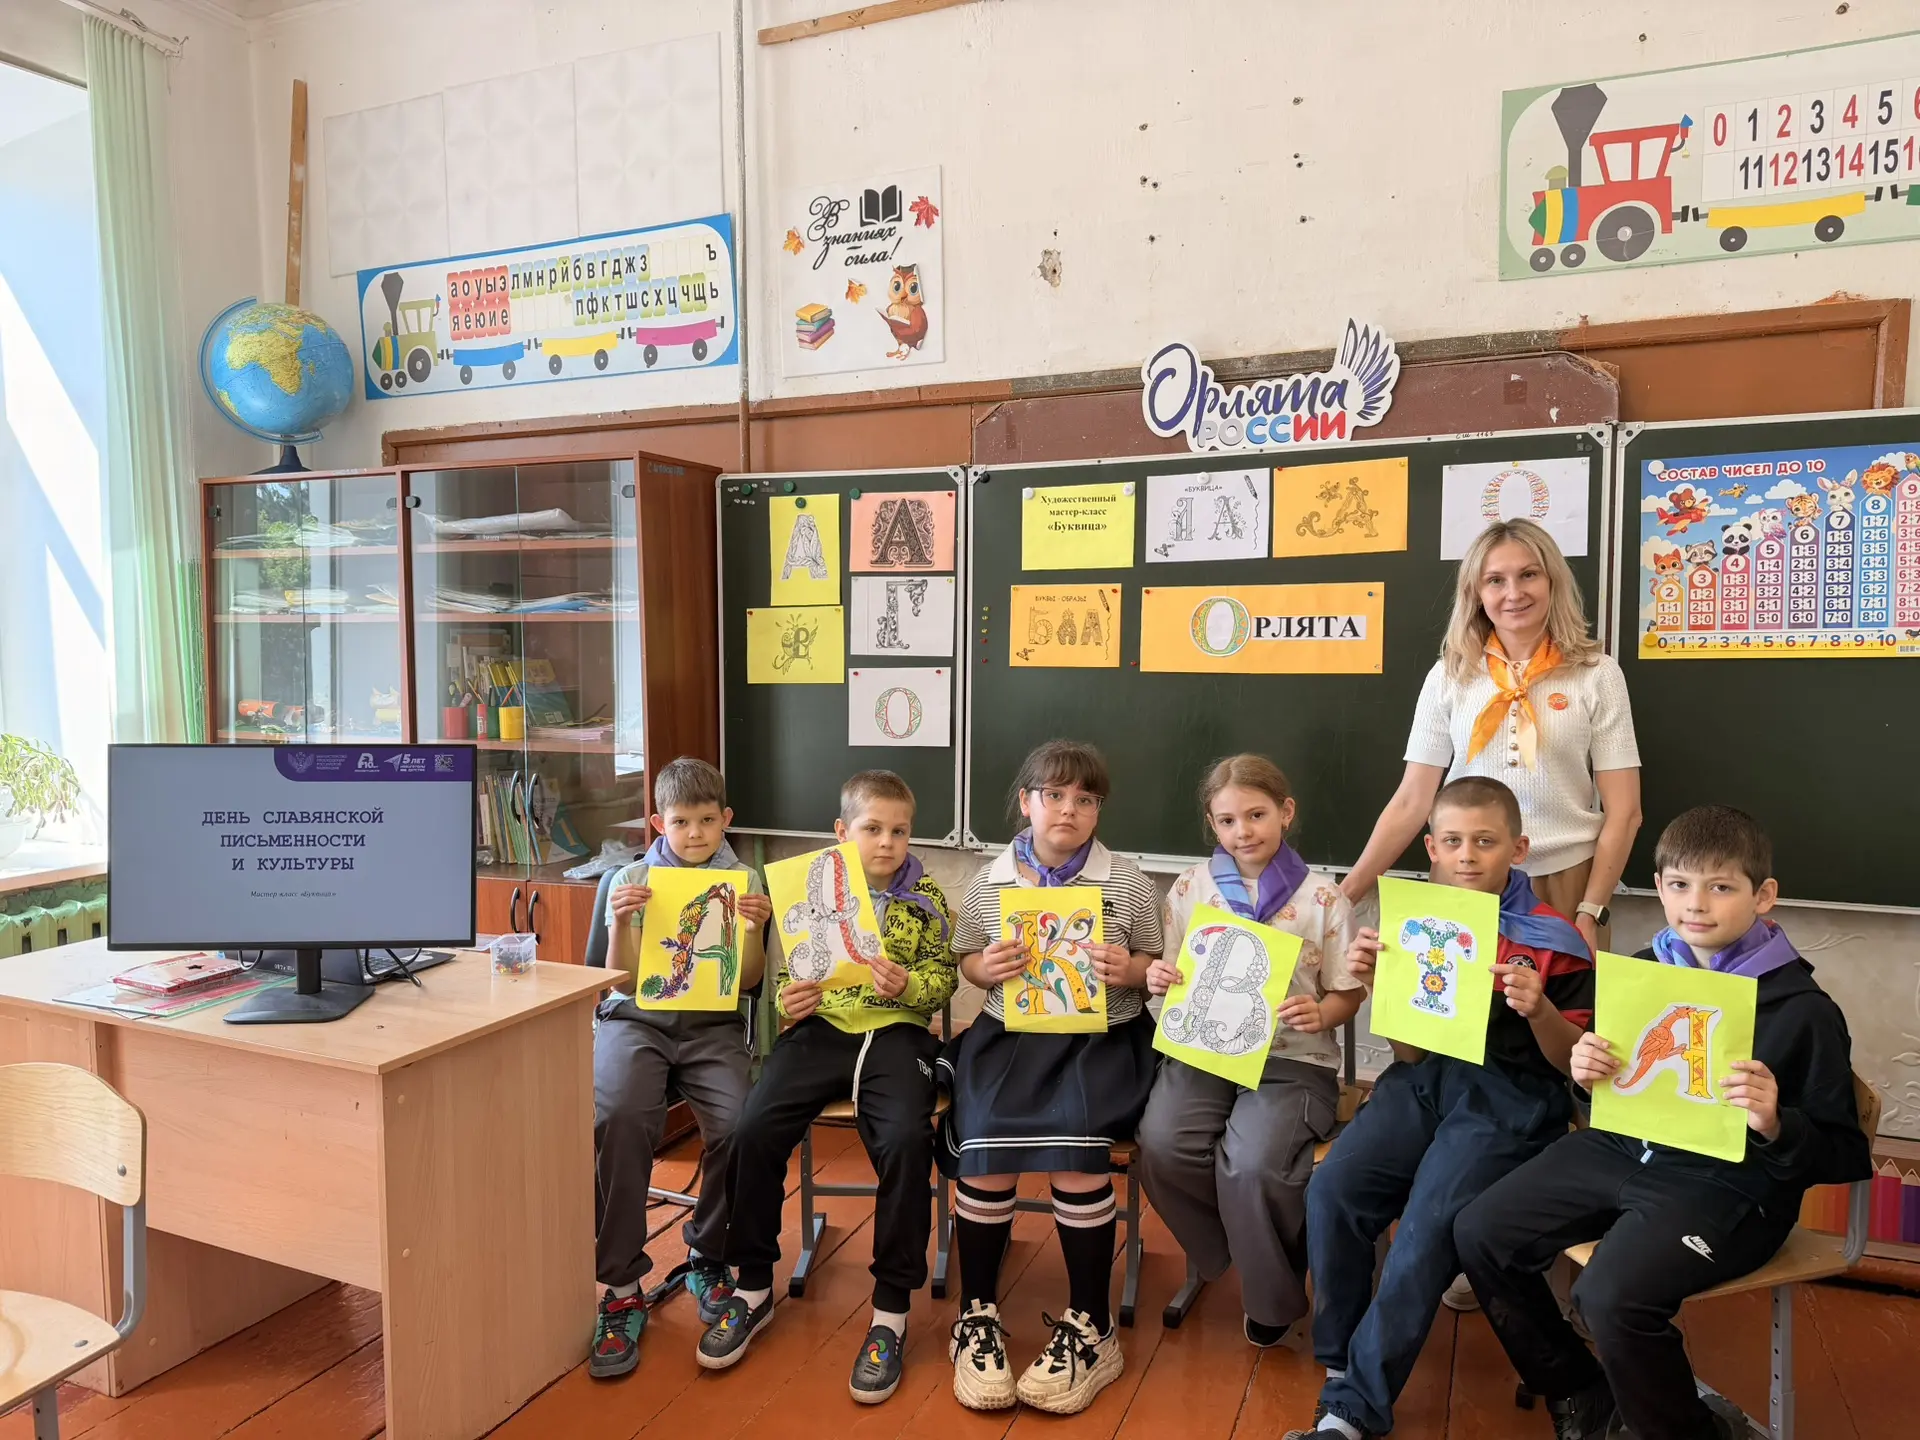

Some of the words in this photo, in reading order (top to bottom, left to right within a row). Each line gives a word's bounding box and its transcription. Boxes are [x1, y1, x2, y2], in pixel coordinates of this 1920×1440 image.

[1713, 112, 1727, 147] 0
[1747, 107, 1758, 142] 1
[1776, 103, 1792, 138] 2
[1810, 99, 1825, 134] 3
[1842, 94, 1858, 129] 4
[1877, 89, 1893, 125] 5
[1739, 155, 1763, 190] 11
[1769, 151, 1798, 186] 12
[1802, 147, 1831, 182] 13
[1834, 142, 1864, 179] 14
[1868, 138, 1899, 175] 15
[1903, 135, 1920, 171] 1
[807, 195, 850, 241] В
[813, 226, 897, 270] знаниях
[844, 236, 903, 267] сила!
[1147, 342, 1348, 438] Орлята
[1658, 467, 1717, 480] СОСТАВ
[1724, 464, 1771, 476] ЧИСЕЛ
[1777, 461, 1801, 474] ДО
[1808, 460, 1825, 472] 10
[1908, 484, 1918, 494] 9
[1041, 495, 1117, 506] Художественный
[1871, 499, 1880, 509] 8
[1049, 508, 1107, 516] мастер-класс
[1835, 515, 1845, 525] 7
[1048, 521, 1107, 533] «Буквица»
[1800, 530, 1809, 540] 6
[1766, 545, 1774, 554] 5
[1731, 558, 1740, 568] 4
[1698, 574, 1707, 584] 3
[1665, 588, 1673, 597] 2
[1657, 637, 1667, 648] 0
[1679, 637, 1685, 648] 1
[1698, 636, 1707, 648] 2
[1720, 636, 1730, 648] 3
[1740, 636, 1751, 647] 4
[1763, 636, 1774, 648] 5
[1785, 635, 1796, 647] 6
[1808, 635, 1818, 647] 7
[1830, 635, 1841, 647] 8
[1854, 634, 1865, 647] 9
[1877, 634, 1897, 647] 10
[202, 811, 250, 826] ДЕНЬ
[263, 807, 384, 824] СЛАВЯНСКОЙ
[220, 834, 366, 847] ПИСЬМЕННОСТИ
[232, 858, 245, 870] И
[257, 857, 354, 870] КУЛЬТУРЫ
